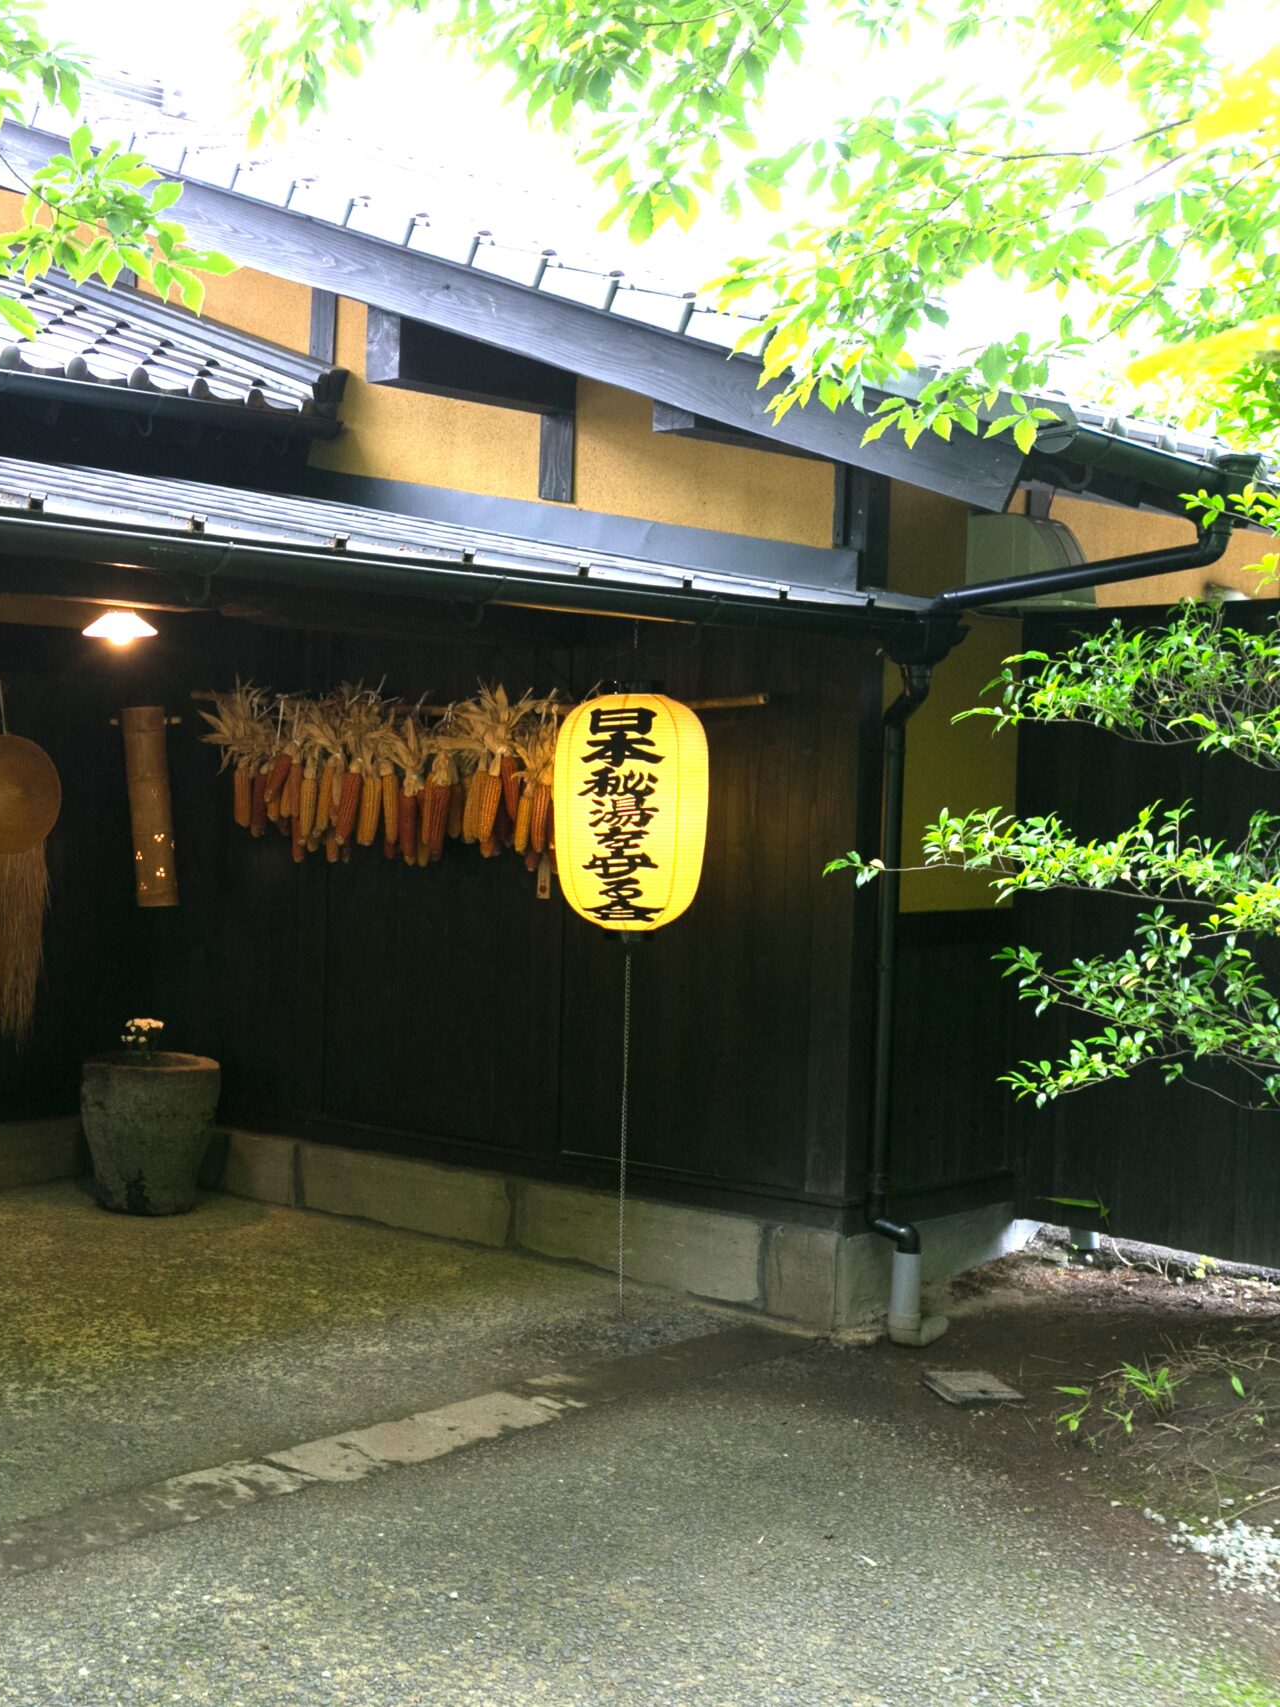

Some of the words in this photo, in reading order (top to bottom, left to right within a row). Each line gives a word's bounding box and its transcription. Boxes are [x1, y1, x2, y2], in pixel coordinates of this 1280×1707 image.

[577, 707, 666, 922] 日本秘湯を守る会
